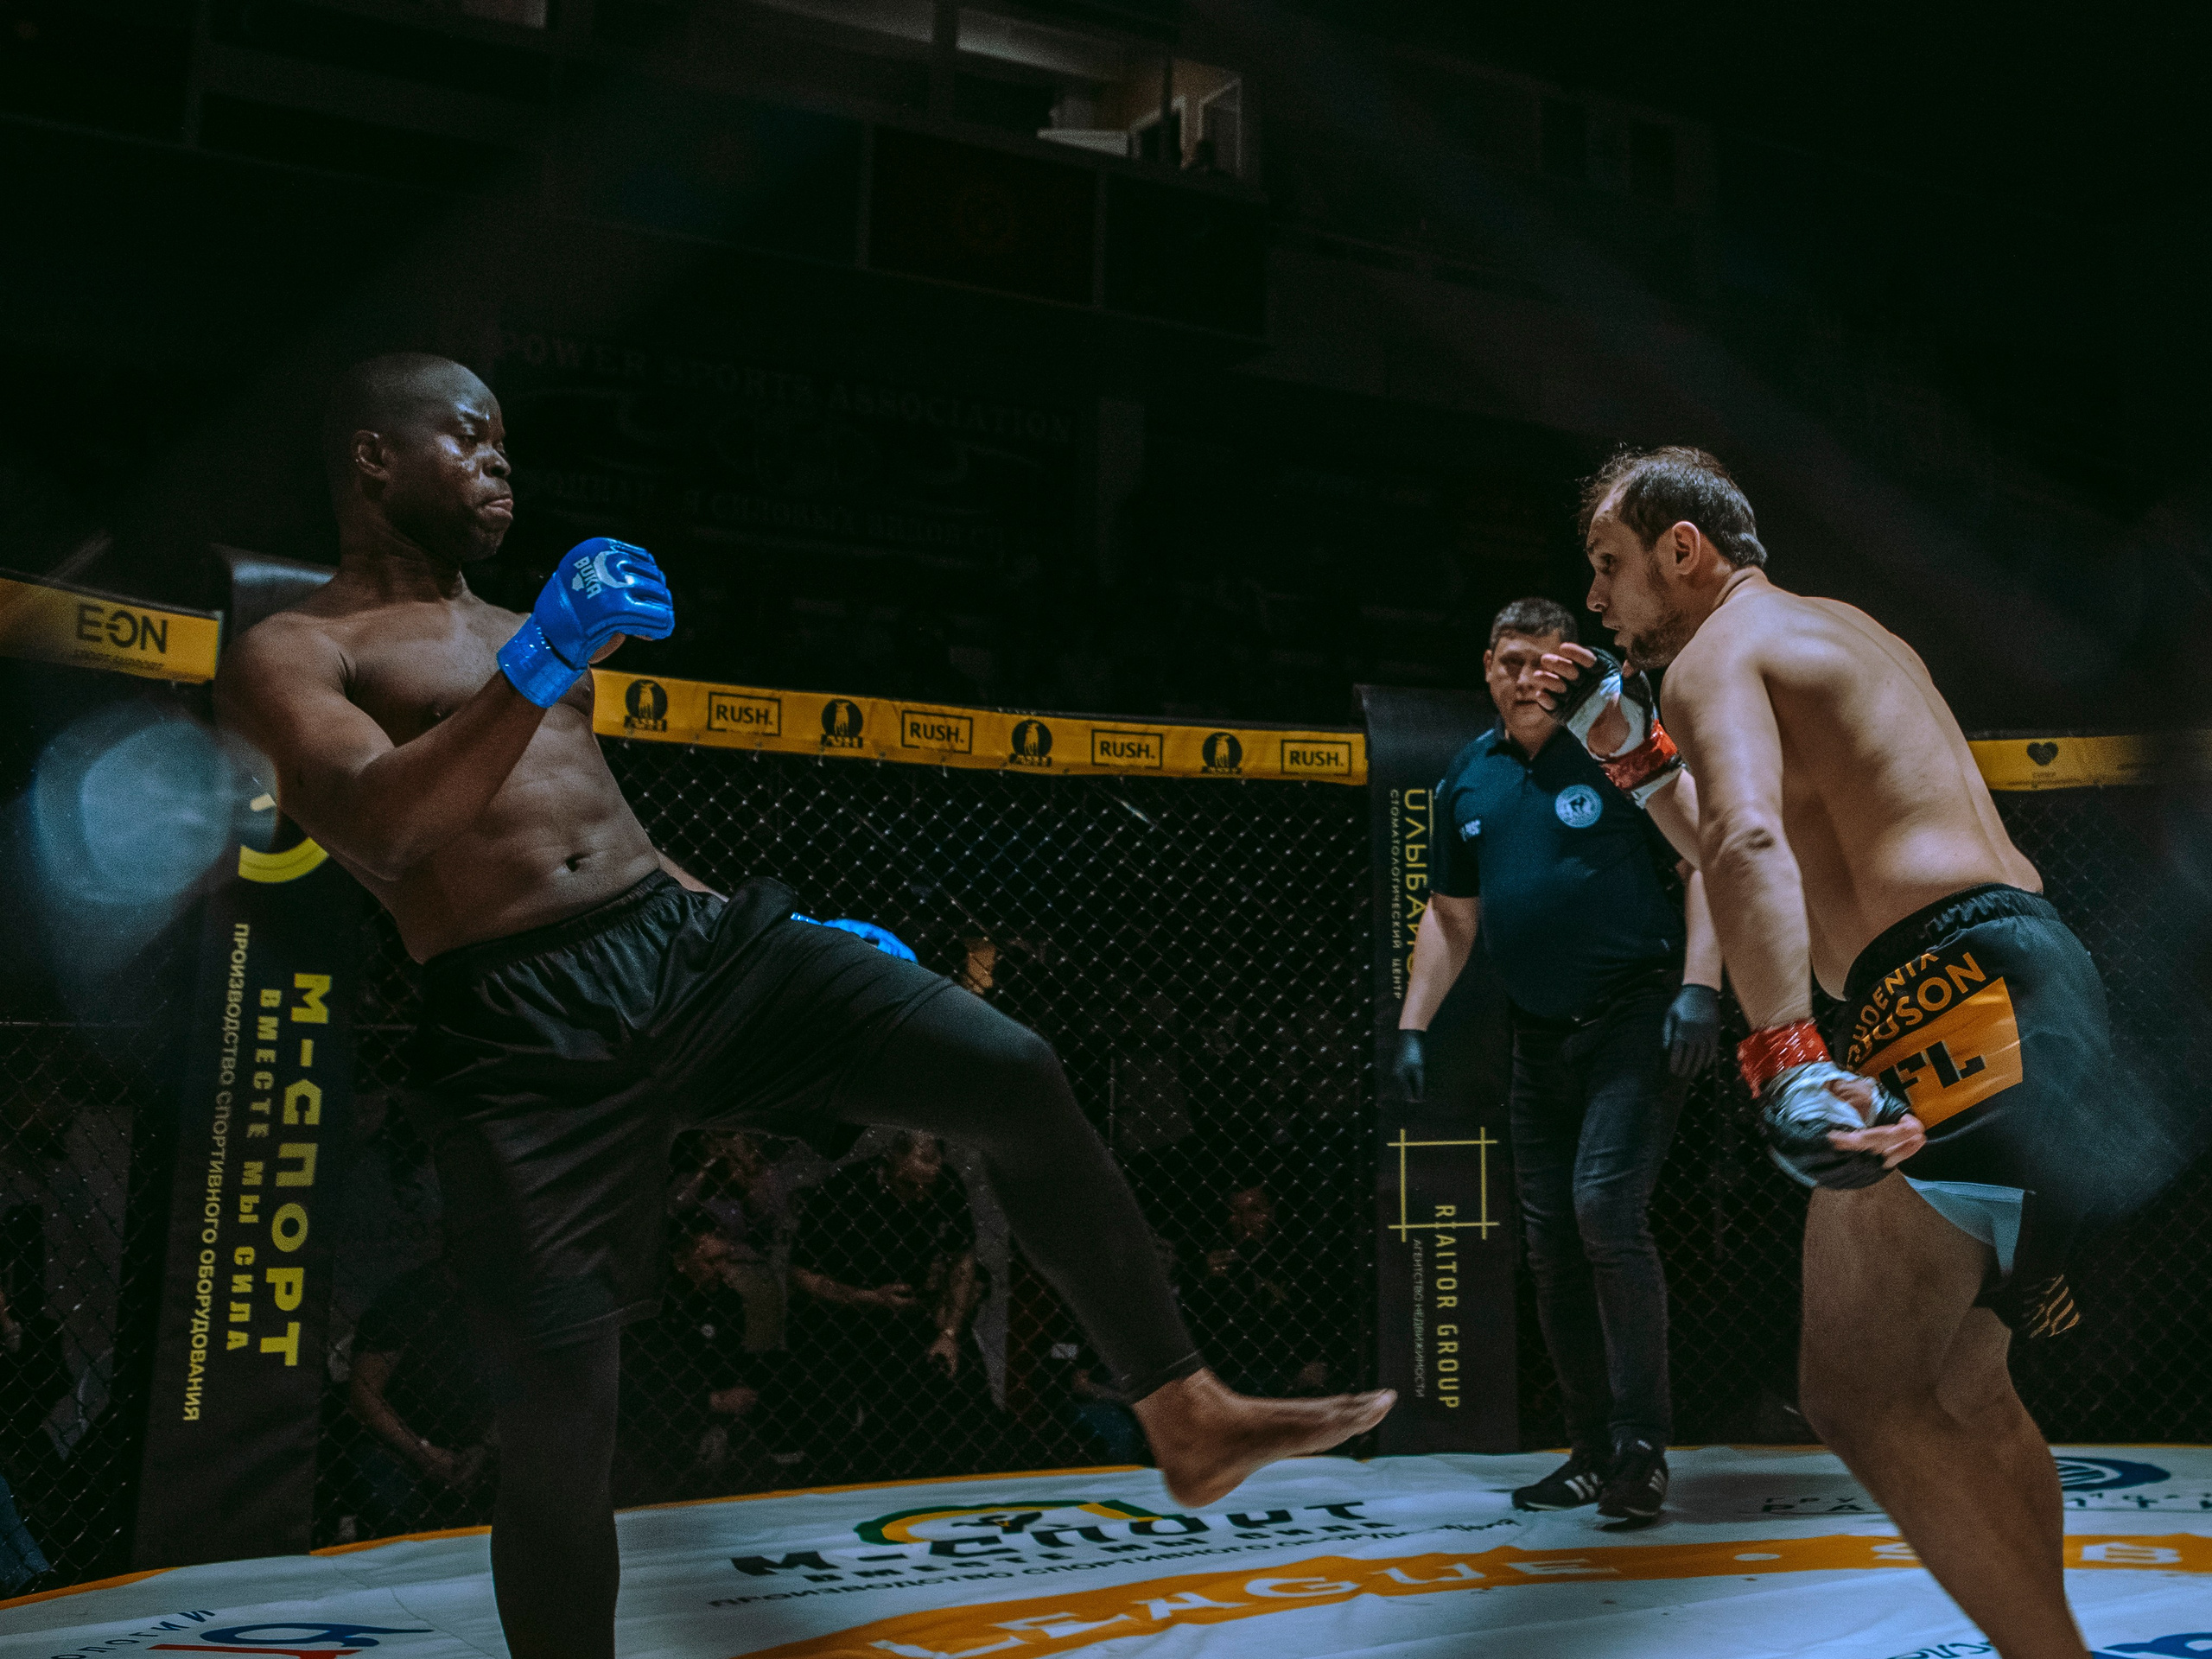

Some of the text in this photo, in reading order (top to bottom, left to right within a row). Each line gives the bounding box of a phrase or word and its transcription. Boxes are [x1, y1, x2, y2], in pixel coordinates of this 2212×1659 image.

[573, 556, 603, 600] BUKA
[715, 703, 773, 726] RUSH.
[910, 721, 964, 744] RUSH.
[1099, 741, 1155, 760] RUSH.
[1289, 750, 1344, 768] RUSH.
[182, 923, 250, 1421] ПРОИЗВОДСТВО СПОРТИВНОГО ОБОРУДОВАНИЯ
[226, 988, 282, 1350] ВМЕСТЕ МЫ СИЛА
[260, 973, 332, 1366] М-СПОРТ
[1436, 1323, 1460, 1408] GROUP
